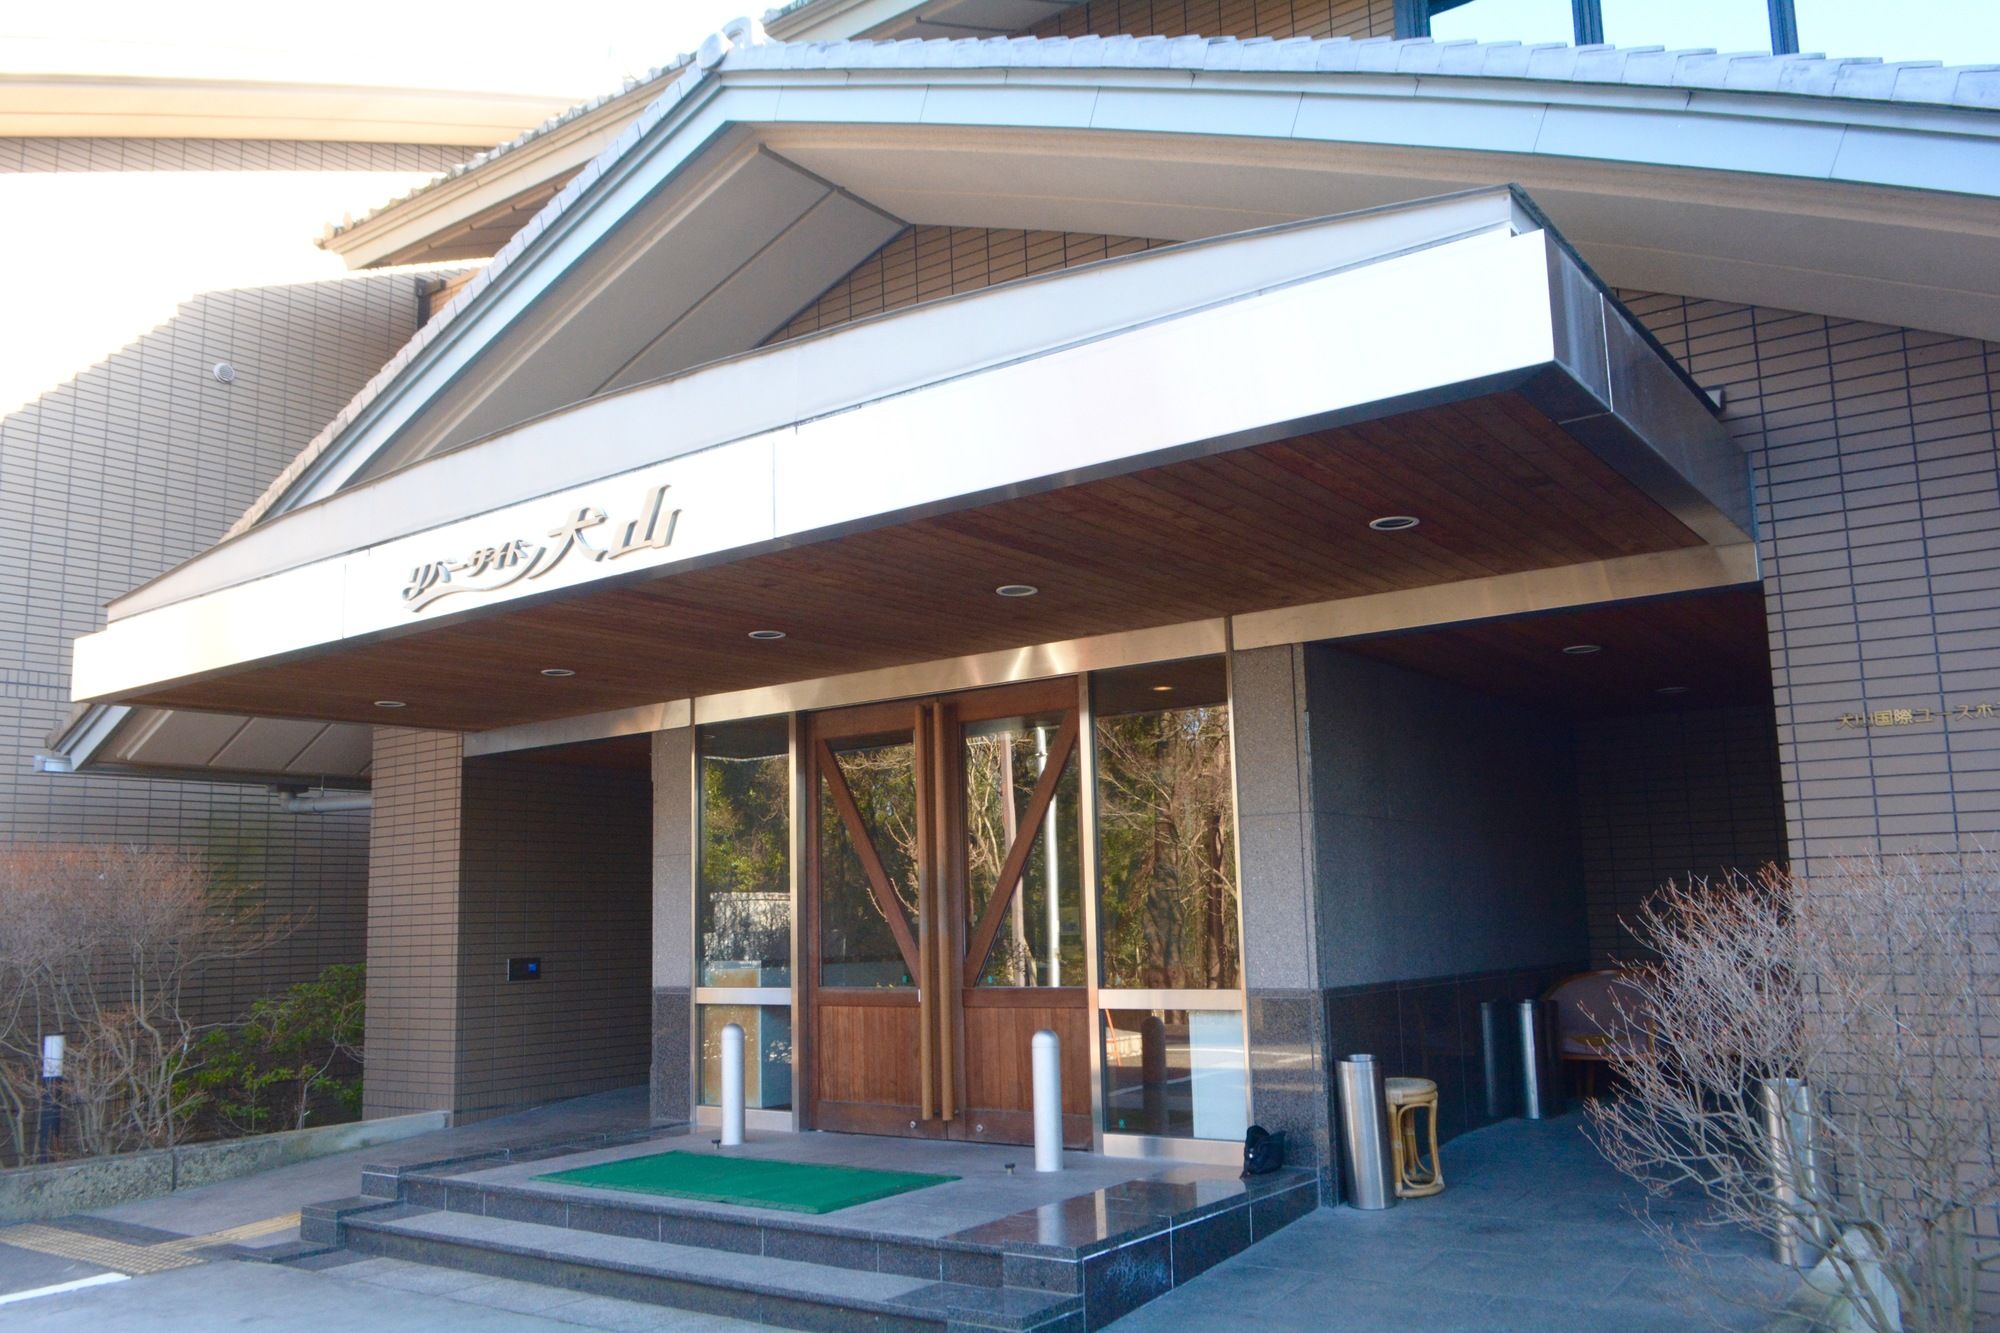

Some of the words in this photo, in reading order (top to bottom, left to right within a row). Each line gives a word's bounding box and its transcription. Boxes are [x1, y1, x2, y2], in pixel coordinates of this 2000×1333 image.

[1837, 701, 2000, 730] 犬山国際ユースホ
